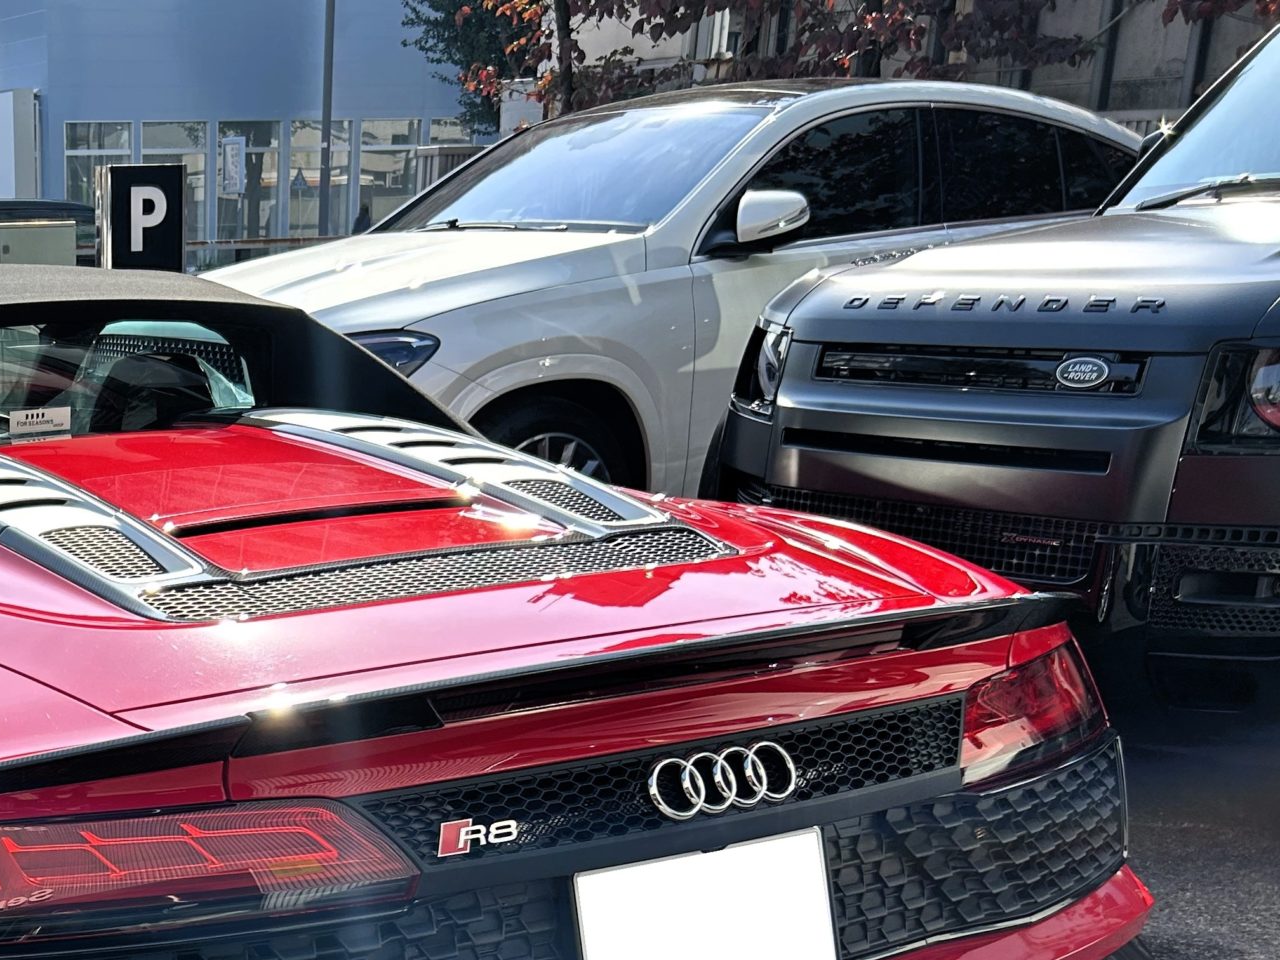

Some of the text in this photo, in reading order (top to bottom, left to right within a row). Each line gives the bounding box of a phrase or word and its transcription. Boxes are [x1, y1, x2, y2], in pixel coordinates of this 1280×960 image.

[131, 186, 167, 252] P
[842, 292, 1167, 313] DEFENDER
[458, 819, 518, 849] R8
